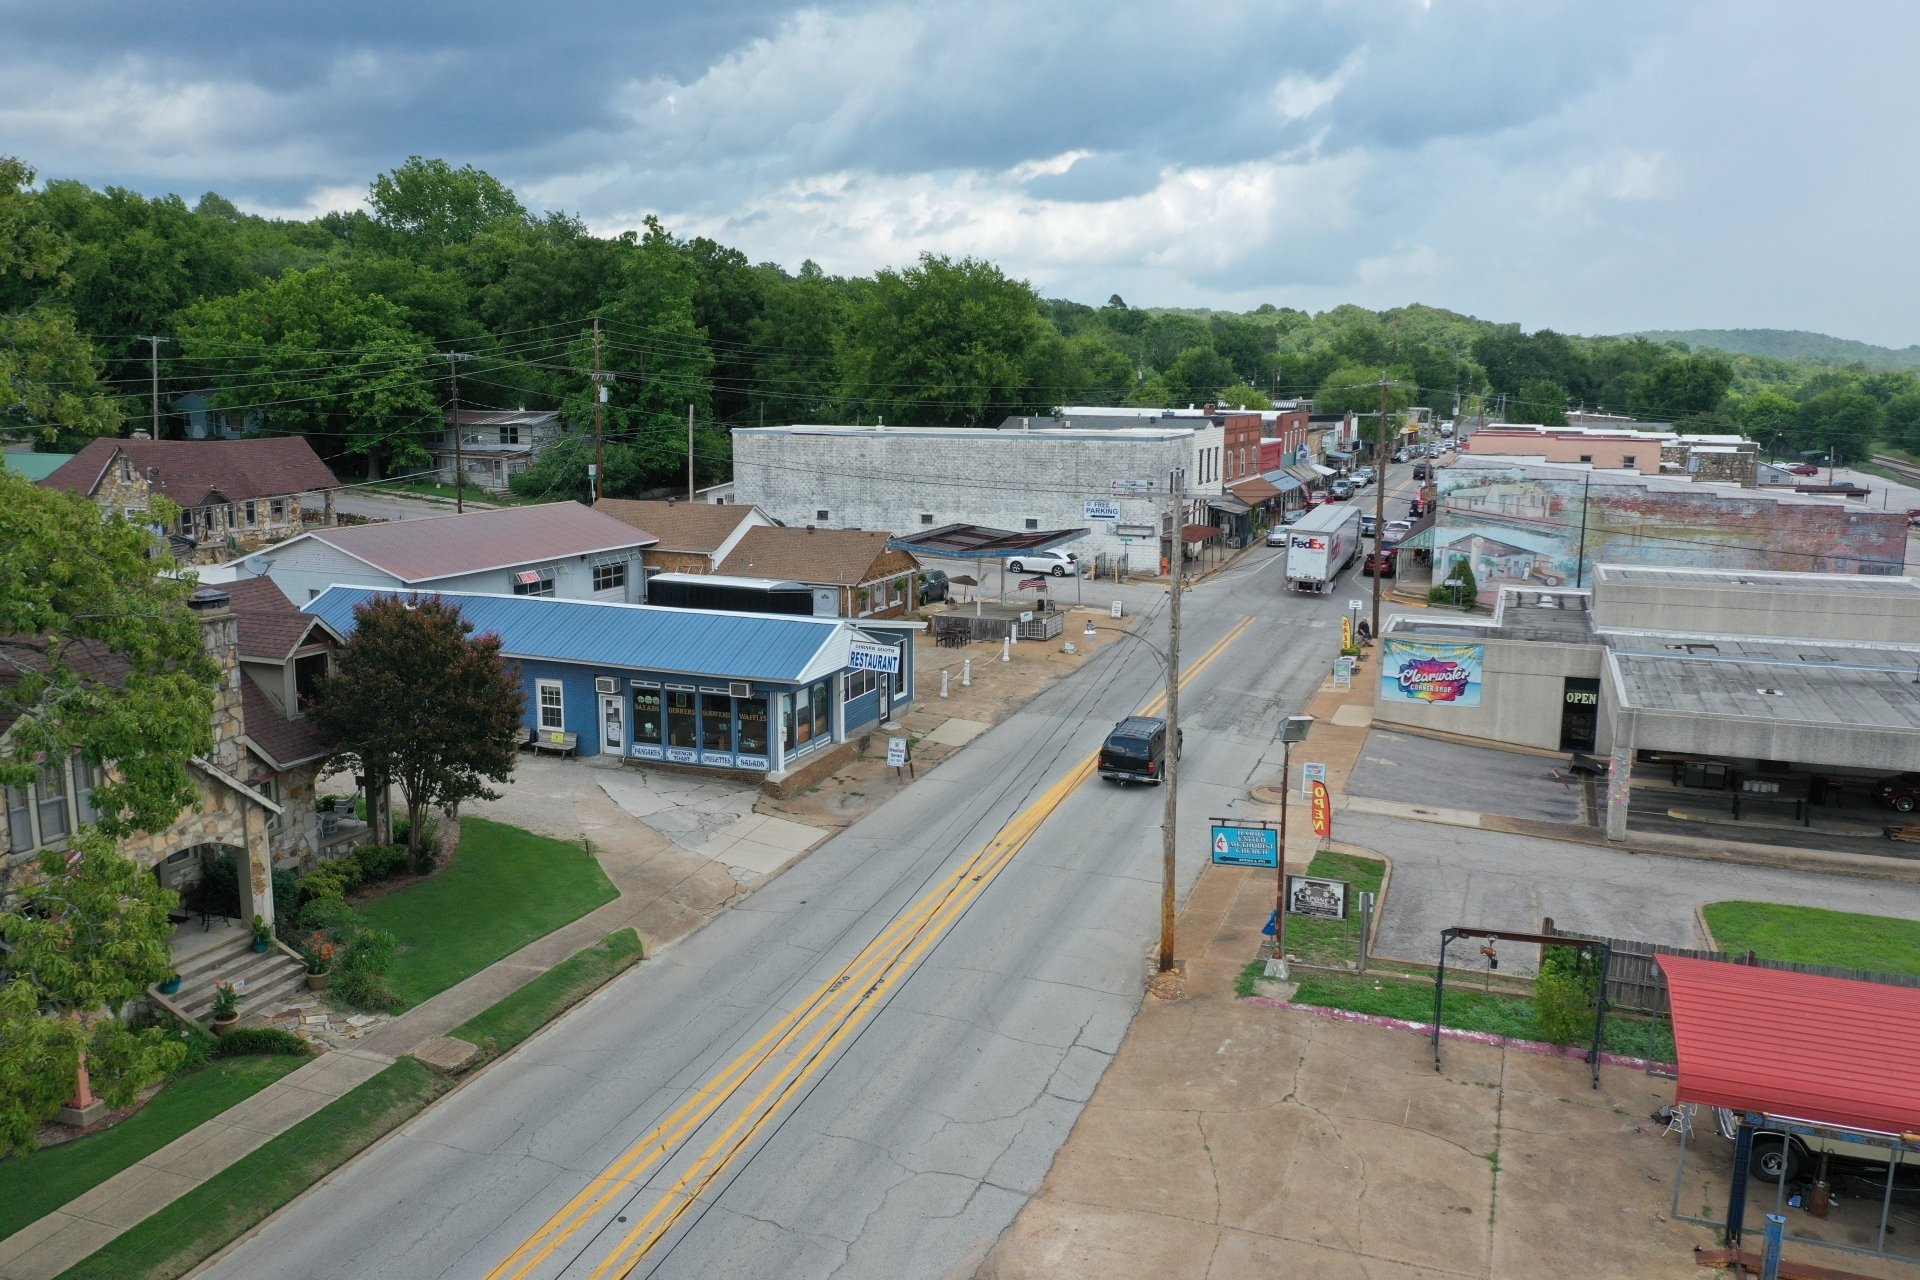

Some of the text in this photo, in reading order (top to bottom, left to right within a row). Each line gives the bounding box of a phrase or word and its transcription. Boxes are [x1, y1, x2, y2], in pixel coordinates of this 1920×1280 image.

[1086, 507, 1118, 515] PARKING
[1291, 537, 1325, 550] FedEx
[850, 651, 898, 672] RESTAURANT
[1396, 667, 1470, 687] Clearwater
[1410, 684, 1434, 692] CORNER
[1566, 692, 1597, 705] OPEN
[634, 704, 660, 712] SALADS
[668, 707, 695, 715] DINNERS
[739, 713, 767, 721] WAFFLES
[634, 747, 661, 757] PANCAKES
[703, 756, 731, 764] OMELETTES
[740, 759, 765, 768] SALADS
[1229, 842, 1273, 850] METHODIST
